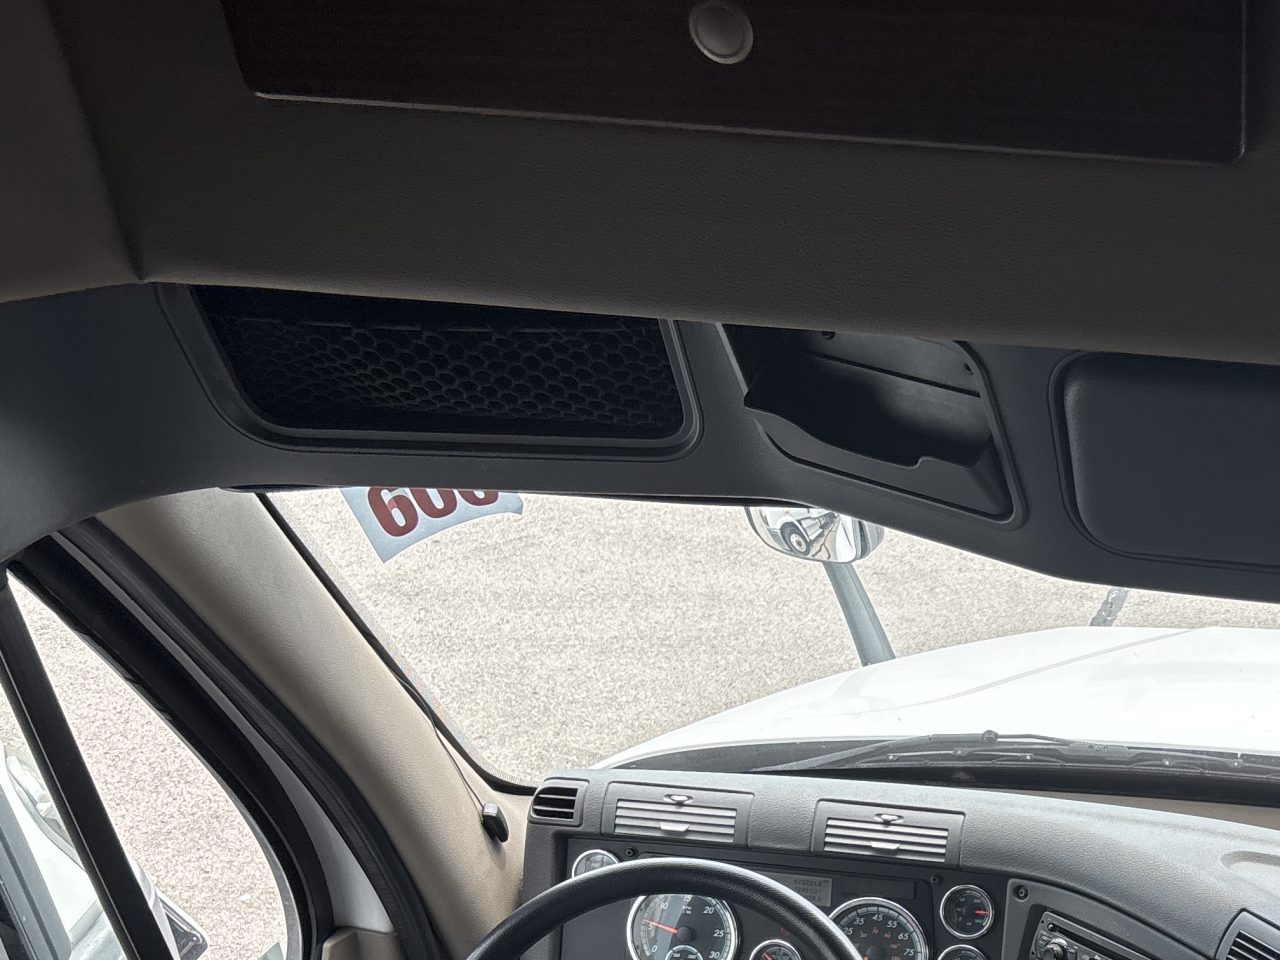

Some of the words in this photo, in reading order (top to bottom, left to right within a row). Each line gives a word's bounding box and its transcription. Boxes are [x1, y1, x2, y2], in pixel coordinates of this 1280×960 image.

[703, 906, 715, 914] 20
[854, 917, 865, 925] 35
[886, 920, 898, 928] 55
[898, 932, 909, 940] 65
[708, 951, 720, 959] 30
[904, 948, 915, 956] 75
